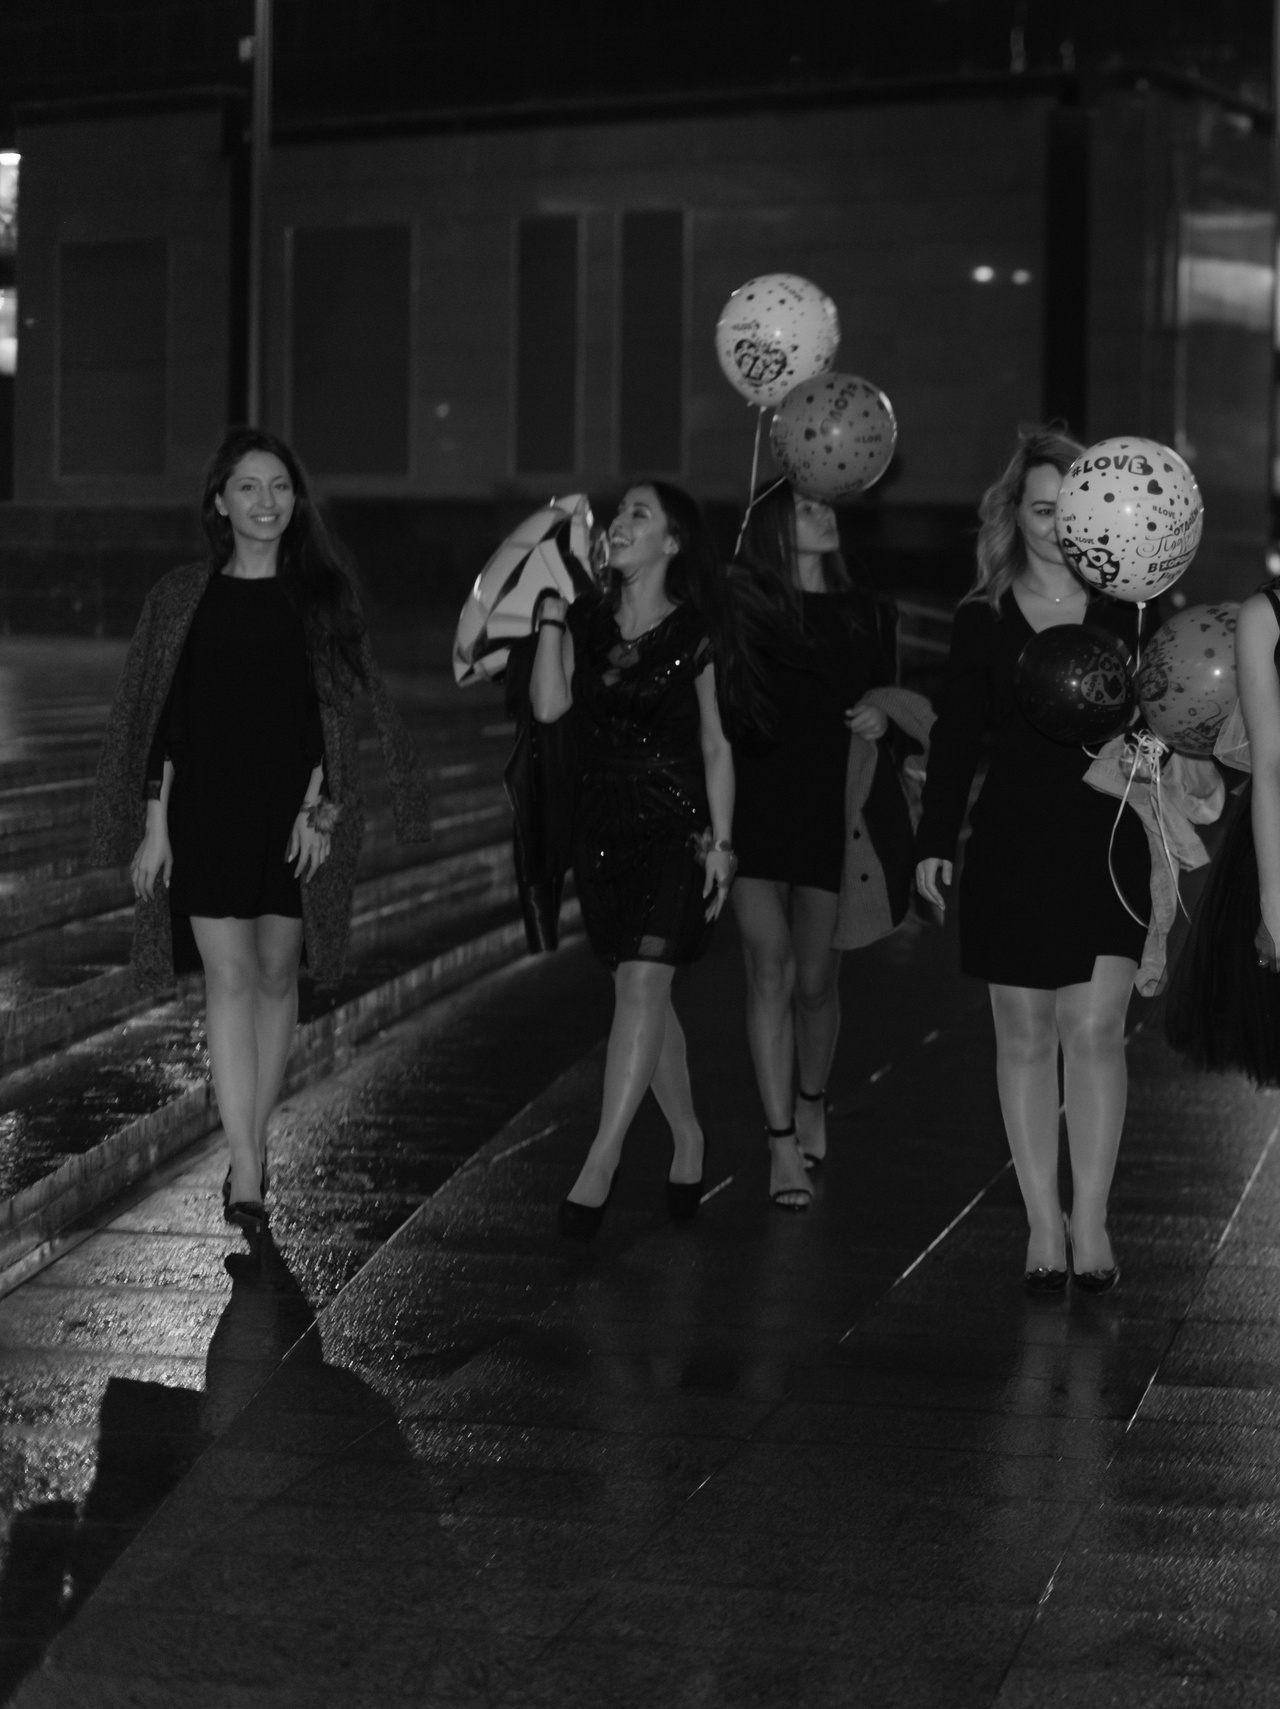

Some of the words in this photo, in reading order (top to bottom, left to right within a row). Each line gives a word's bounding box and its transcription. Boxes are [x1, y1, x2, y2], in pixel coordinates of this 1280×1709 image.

[1071, 455, 1153, 478] #LOVE
[1152, 505, 1176, 520] #LOVE
[1075, 536, 1095, 545] #LOVE
[1148, 562, 1158, 573] В
[1085, 673, 1099, 698] #LOVE
